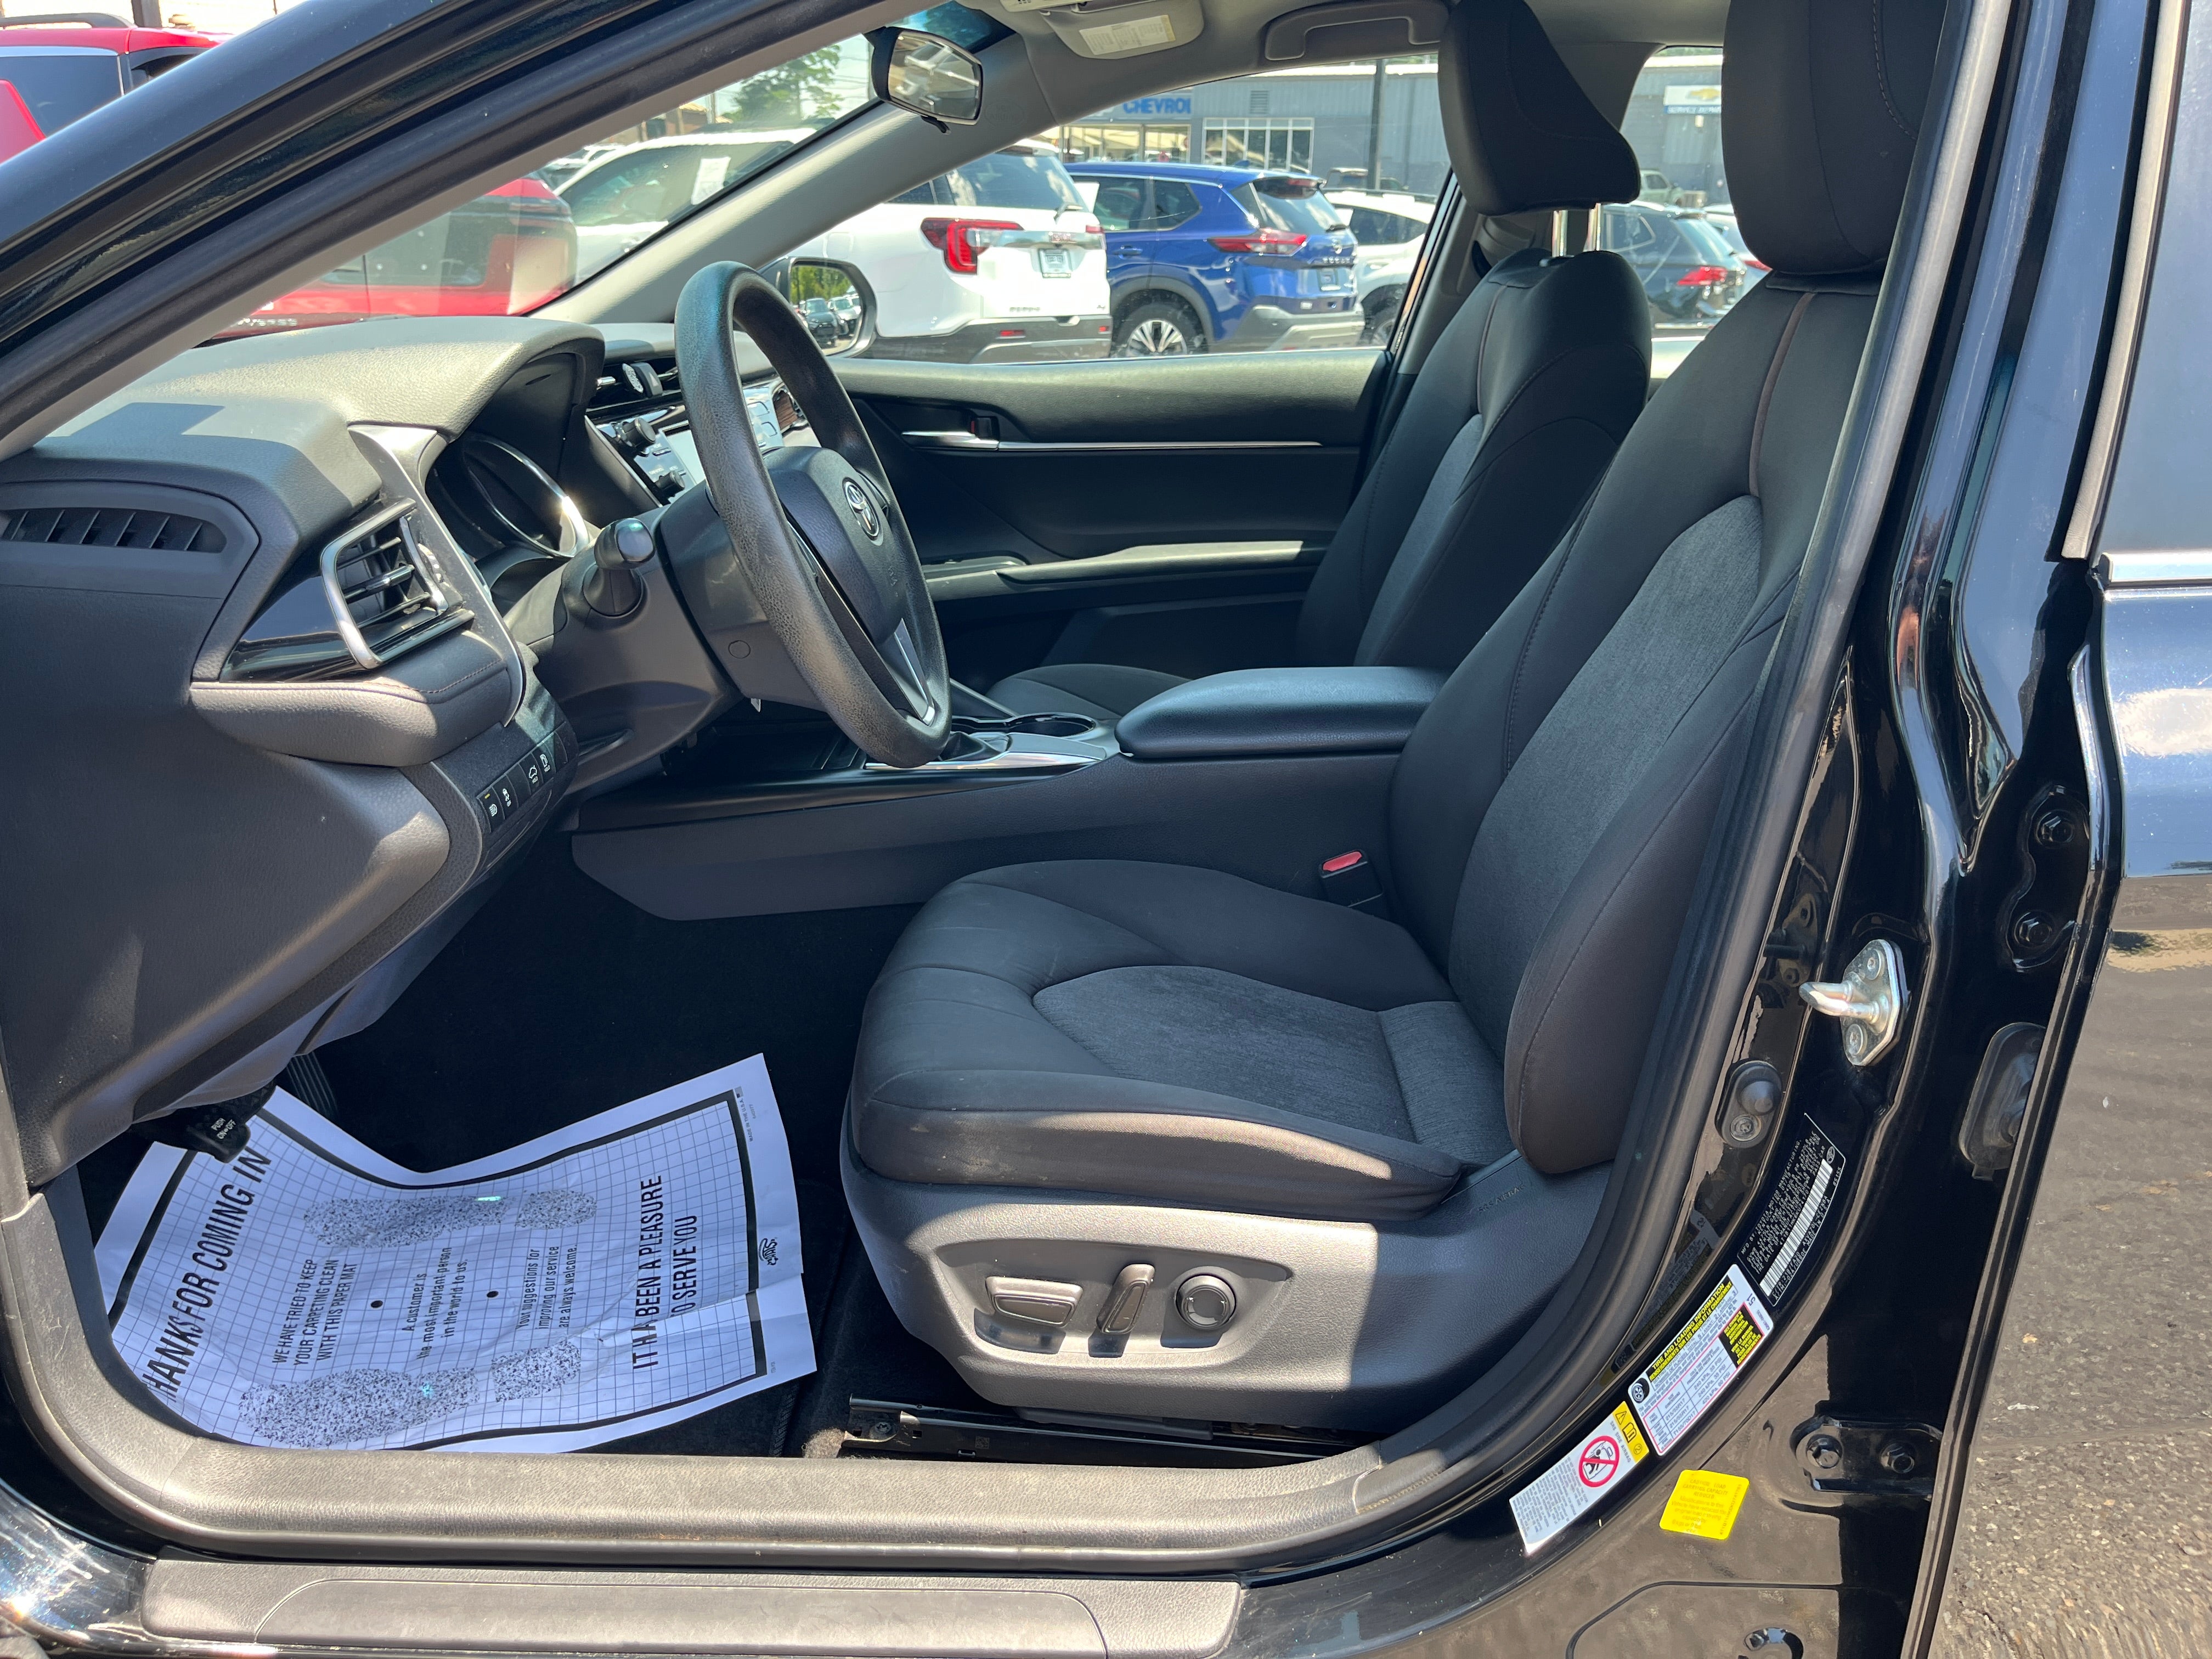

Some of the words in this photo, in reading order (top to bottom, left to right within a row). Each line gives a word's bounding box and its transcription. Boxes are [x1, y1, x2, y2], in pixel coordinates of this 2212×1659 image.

[211, 1118, 226, 1131] PUSH
[233, 1146, 272, 1183] IN
[193, 1184, 255, 1272] COMING
[639, 1175, 663, 1257] PLEASURE
[674, 1215, 697, 1246] YOU
[437, 1247, 452, 1273] person
[527, 1249, 540, 1260] for
[545, 1246, 559, 1276] service
[563, 1244, 578, 1286] welcome.
[639, 1258, 662, 1270] A
[300, 1259, 318, 1280] KEEP
[319, 1260, 339, 1286] CLEAN
[340, 1263, 357, 1280] MAT
[413, 1273, 427, 1283] is
[452, 1274, 465, 1284] to
[672, 1246, 697, 1300] SERVE
[172, 1272, 219, 1321] FOR
[296, 1283, 311, 1293] TO
[331, 1282, 352, 1308] PAPER
[425, 1274, 446, 1318] important
[522, 1263, 538, 1311] suggestions
[545, 1278, 556, 1291] our
[635, 1276, 662, 1317] BEEN
[286, 1296, 306, 1321] TRIED
[407, 1283, 425, 1324] customer
[449, 1286, 463, 1310] world
[558, 1286, 576, 1314] always
[670, 1302, 696, 1318] O
[1744, 1293, 1757, 1306] 51
[302, 1288, 330, 1336] CARPETING
[324, 1308, 343, 1331] THIS
[443, 1310, 458, 1325] the
[515, 1311, 531, 1330] Your
[535, 1294, 556, 1329] improving
[558, 1316, 569, 1328] are
[1678, 1338, 1686, 1349] SUR
[1691, 1318, 1703, 1334] PNEUS
[1702, 1313, 1707, 1321] ET
[1706, 1307, 1712, 1316] LE
[1711, 1281, 1732, 1310] CHARGEMENT
[278, 1324, 298, 1348] HAVE
[423, 1317, 437, 1342] most
[441, 1327, 455, 1338] in
[631, 1319, 658, 1348] HA
[1652, 1355, 1663, 1370] TIRE
[1663, 1344, 1674, 1358] AND
[1673, 1320, 1695, 1346] LOADING
[1694, 1283, 1724, 1322] INFORMATION
[272, 1349, 290, 1363] WE
[294, 1339, 314, 1365] YOUR
[317, 1334, 337, 1361] WITH
[416, 1346, 432, 1359] the
[632, 1351, 658, 1370] IT
[1621, 1444, 1631, 1463] AIRBAG
